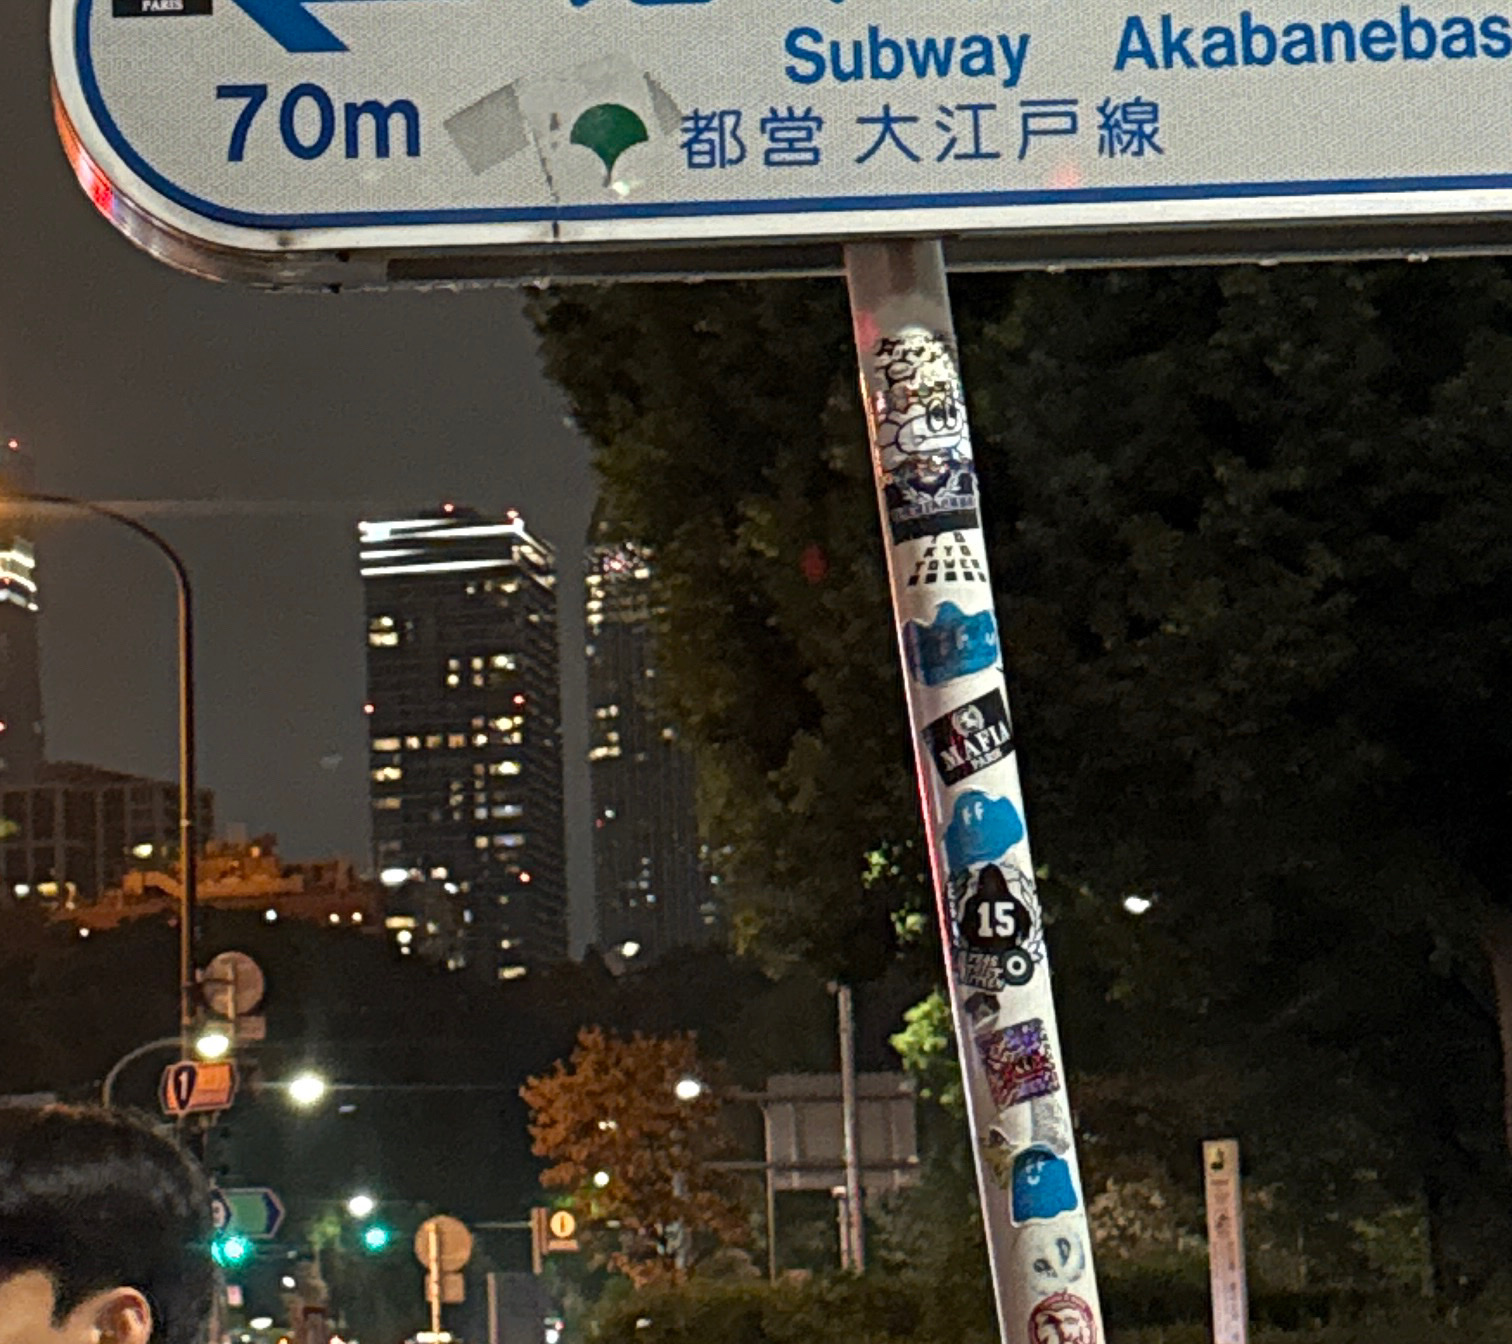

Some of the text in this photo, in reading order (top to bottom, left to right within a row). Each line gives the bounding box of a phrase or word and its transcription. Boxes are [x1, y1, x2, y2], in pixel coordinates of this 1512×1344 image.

[783, 4, 1512, 90] Subway Akabanebas
[215, 82, 422, 163] 70m
[939, 720, 1011, 773] MAFIA
[977, 901, 1016, 938] 15
